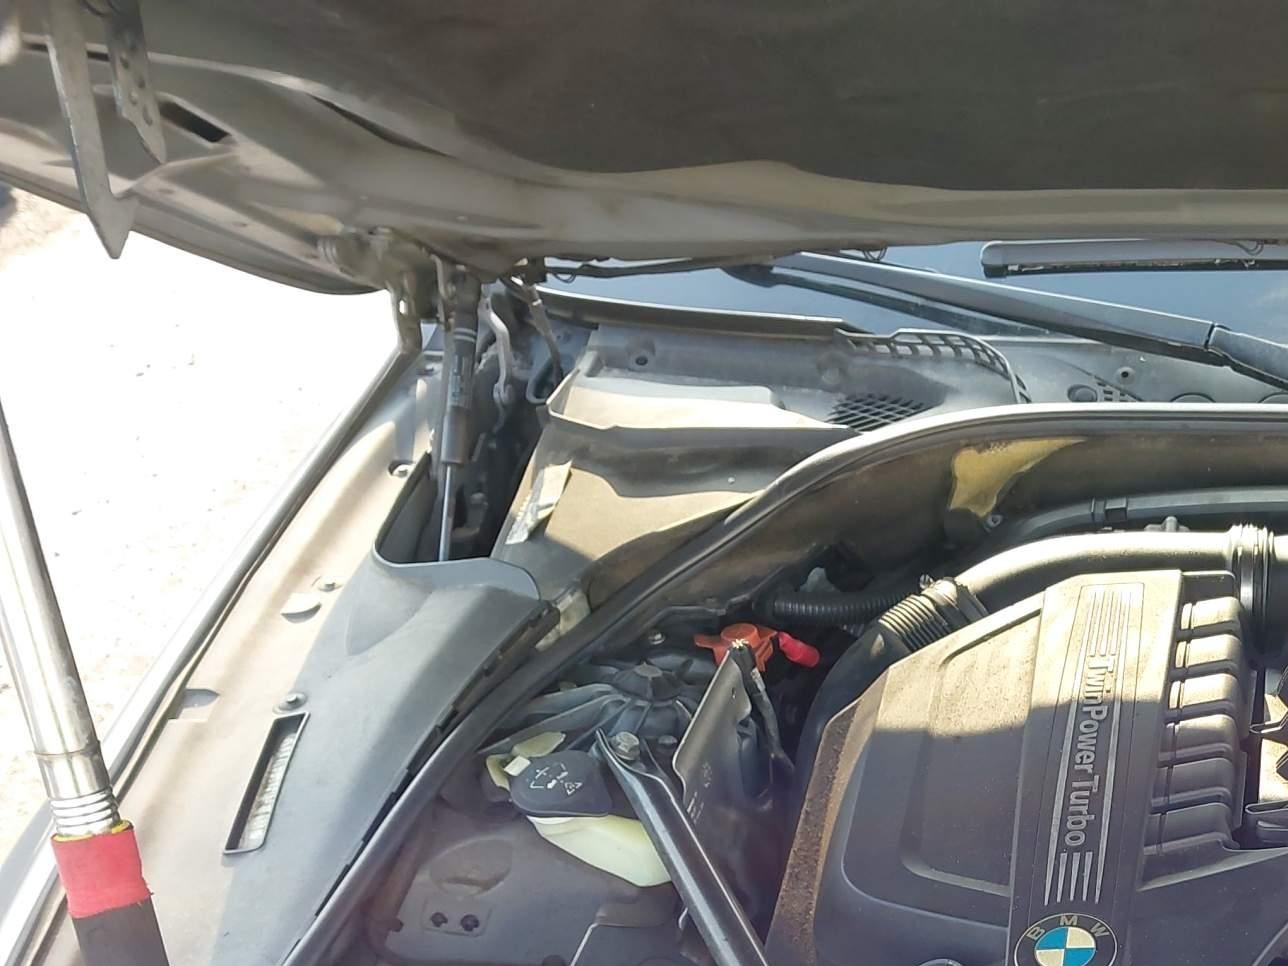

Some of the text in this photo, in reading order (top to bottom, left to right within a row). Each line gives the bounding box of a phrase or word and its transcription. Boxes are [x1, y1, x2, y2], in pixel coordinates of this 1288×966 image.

[1063, 656, 1116, 847] TwinPower Turbo
[1026, 914, 1111, 941] BMW
